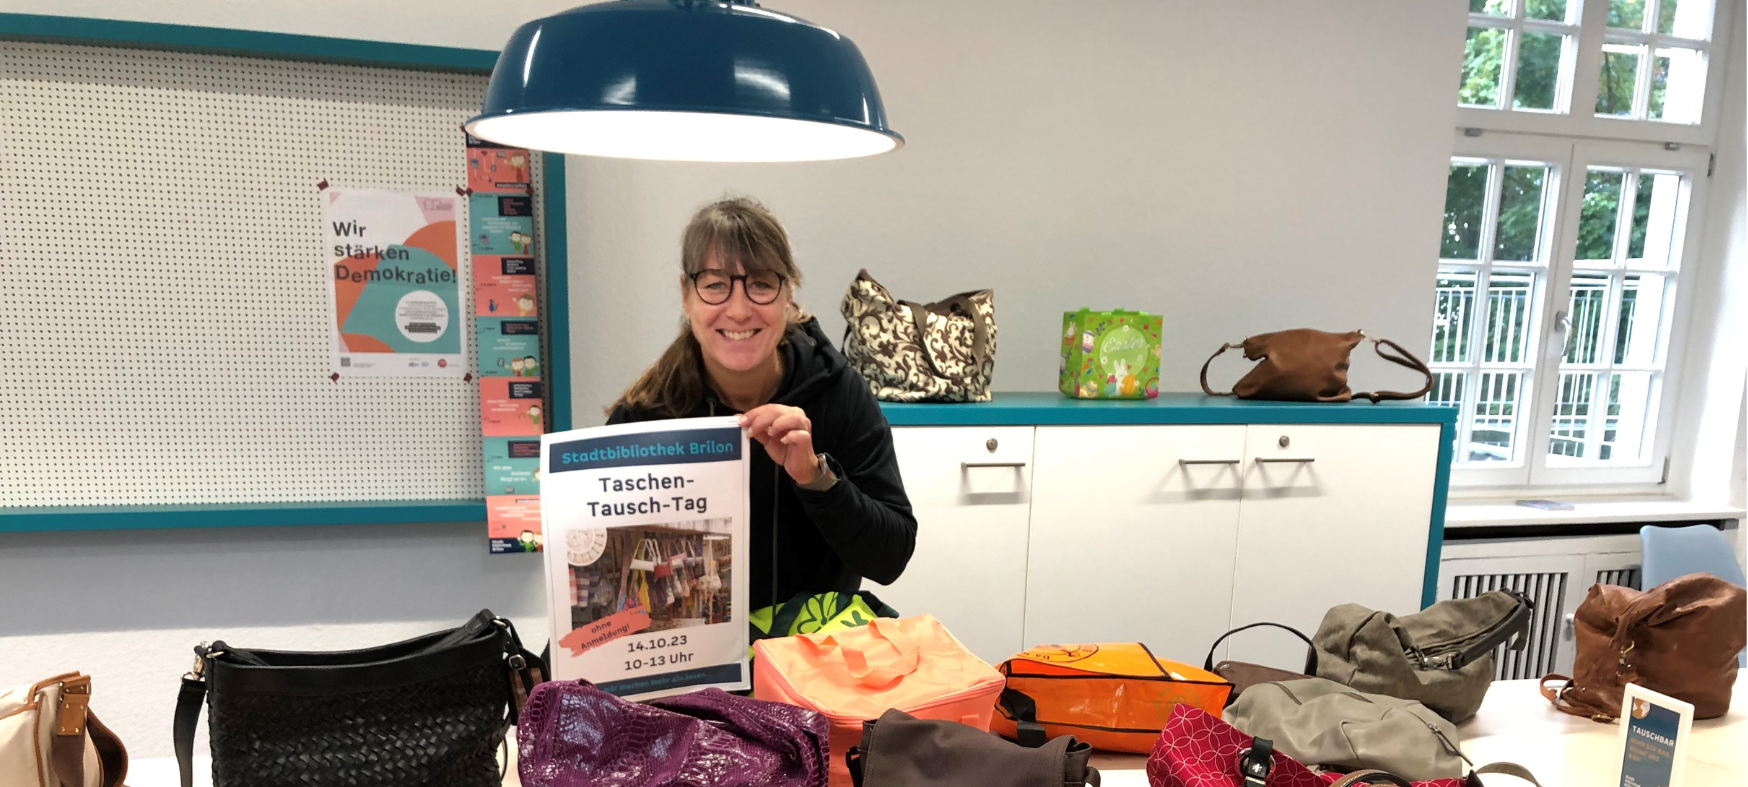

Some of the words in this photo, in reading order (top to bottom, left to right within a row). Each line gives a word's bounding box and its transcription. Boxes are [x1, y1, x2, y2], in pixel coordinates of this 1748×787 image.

[332, 219, 367, 238] Wir
[334, 244, 410, 261] stärken
[335, 264, 458, 284] Demokratie!
[562, 442, 685, 464] Stadtbibliothek
[689, 440, 734, 455] Brilon
[598, 473, 695, 493] Taschen-
[587, 496, 708, 518] Tausch-Tag
[580, 623, 631, 650] Anmeldung!
[591, 620, 613, 634] ohne
[627, 635, 688, 653] 14.10.23
[624, 655, 666, 671] 10-13
[669, 650, 694, 665] Uhr
[619, 680, 650, 691] machen
[650, 677, 670, 686] mehr
[672, 674, 684, 683] als
[1632, 725, 1675, 747] TAUSCHBAR
